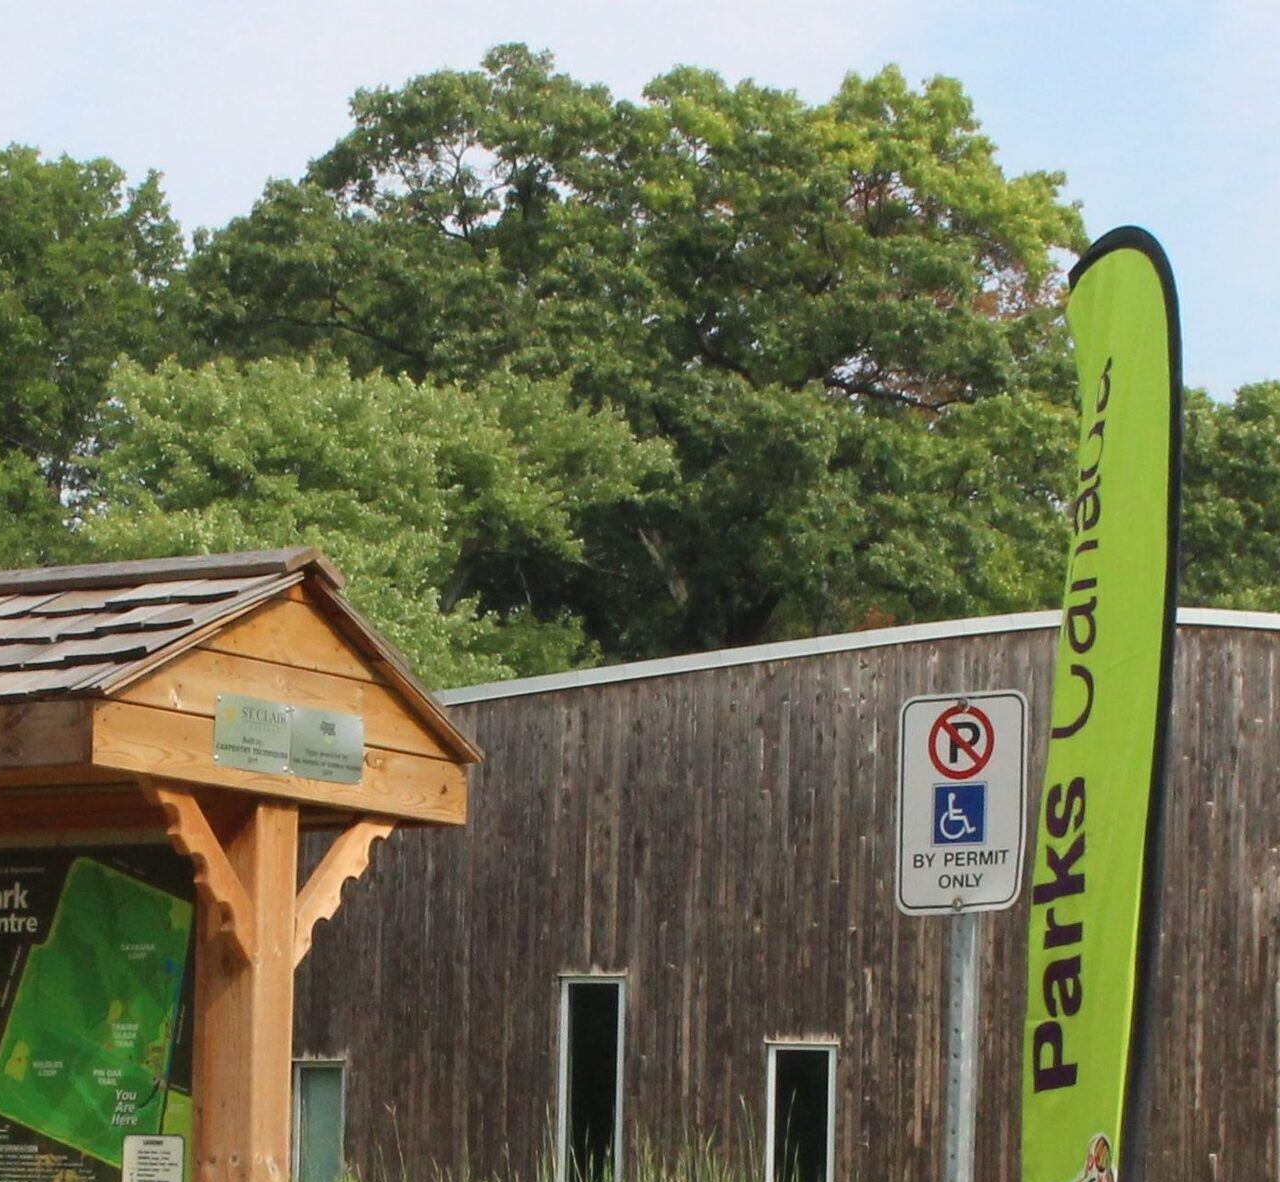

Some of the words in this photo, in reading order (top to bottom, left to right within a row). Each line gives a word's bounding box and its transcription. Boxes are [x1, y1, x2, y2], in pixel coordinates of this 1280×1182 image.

[255, 710, 287, 725] CLAIR
[913, 853, 936, 869] BY
[944, 850, 1010, 867] PERMIT
[938, 873, 983, 889] ONLY
[1033, 776, 1086, 1094] Parks
[115, 1089, 137, 1101] You
[115, 1101, 135, 1113] Are
[111, 1113, 138, 1126] Here
